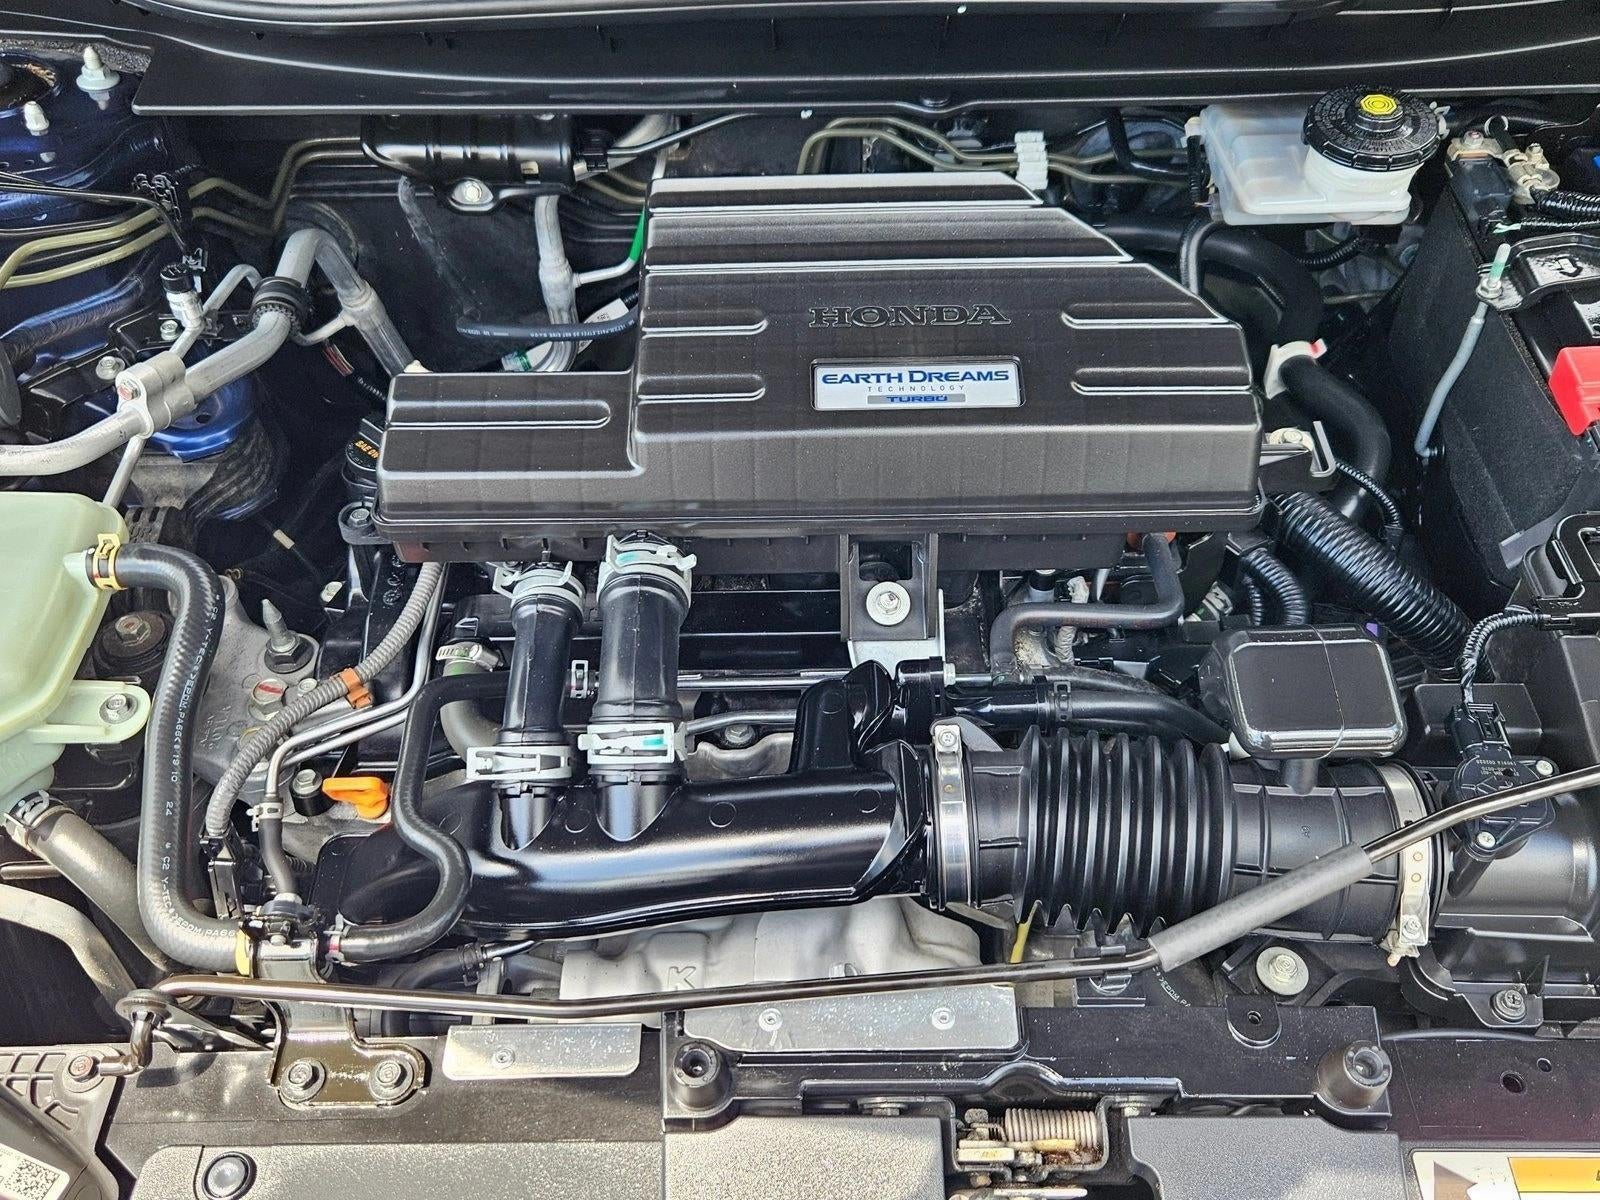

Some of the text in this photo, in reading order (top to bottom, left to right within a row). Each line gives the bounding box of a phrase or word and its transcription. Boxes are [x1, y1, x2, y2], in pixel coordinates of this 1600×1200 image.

[809, 304, 1012, 328] HONDA
[822, 370, 1009, 384] EARTH DREAMS
[165, 801, 174, 816] 24
[162, 856, 171, 871] C2
[667, 966, 697, 990] K
